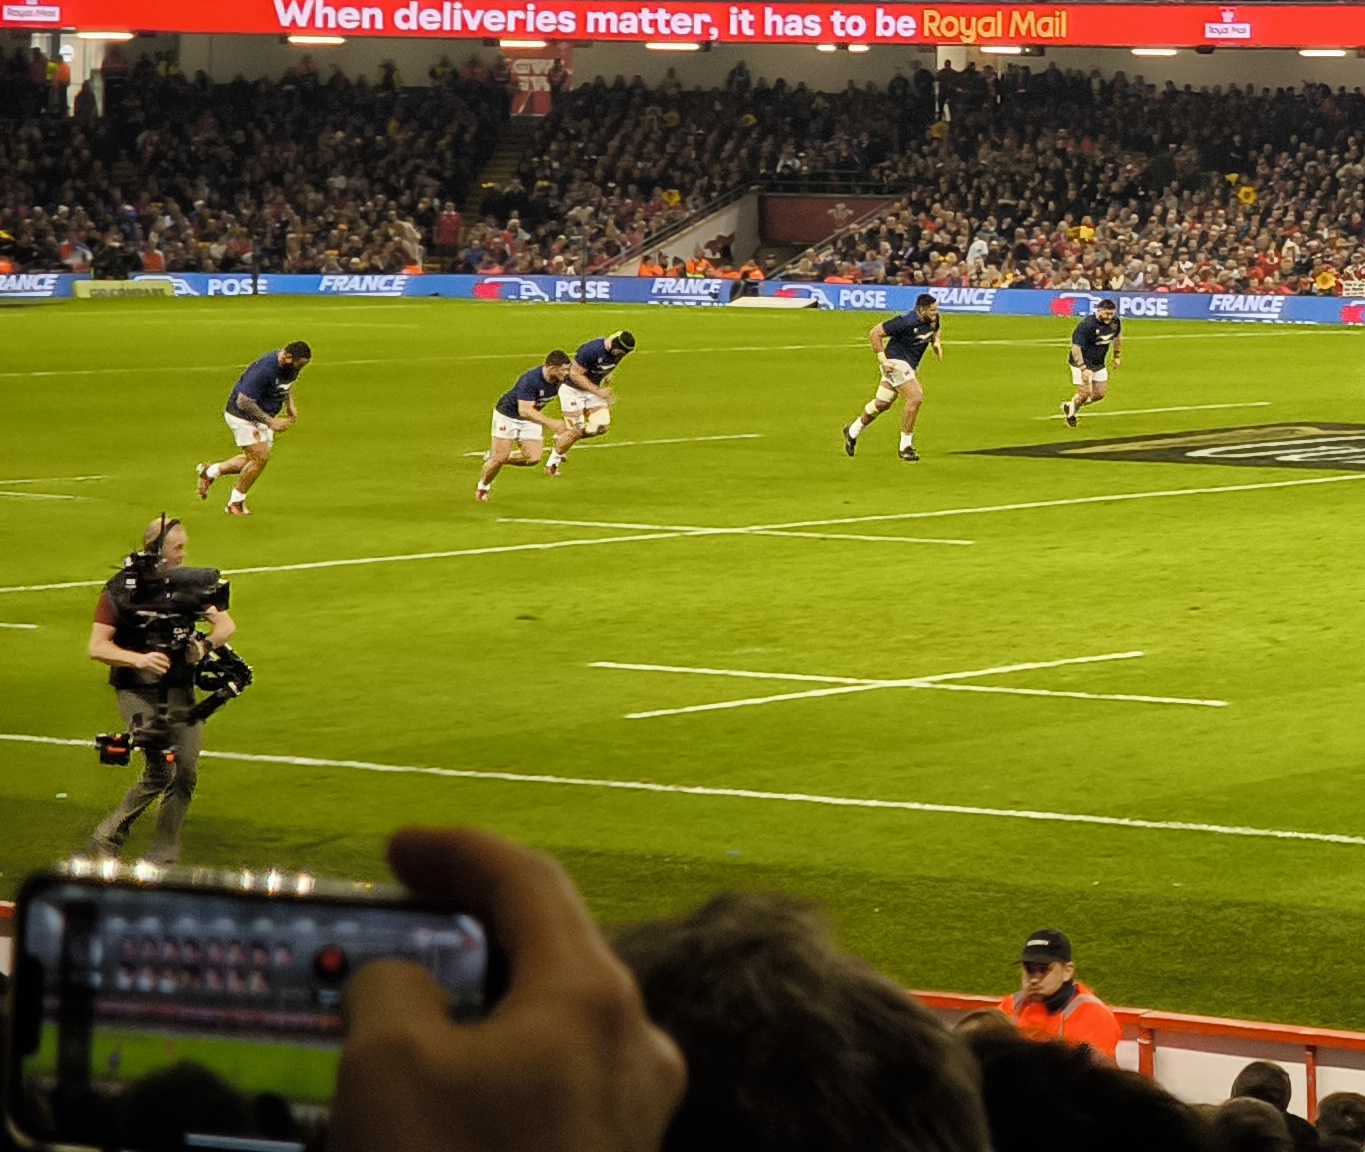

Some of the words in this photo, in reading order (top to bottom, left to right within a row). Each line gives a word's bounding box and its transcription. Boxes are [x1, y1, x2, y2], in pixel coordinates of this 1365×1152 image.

[274, 0, 388, 30] When
[394, 1, 576, 34] deliveries
[586, 8, 719, 40] matter,
[730, 6, 755, 35] it
[765, 7, 822, 37] has
[830, 12, 866, 37] to
[876, 9, 917, 37] be
[922, 10, 1002, 44] Royal
[1009, 10, 1068, 39] Mail
[207, 278, 268, 296] POSE
[319, 275, 408, 292] FRANCE
[651, 278, 722, 295] FRANCE
[839, 289, 886, 309] POSE
[1119, 298, 1168, 316] POSE
[1208, 294, 1285, 312] FRANCE
